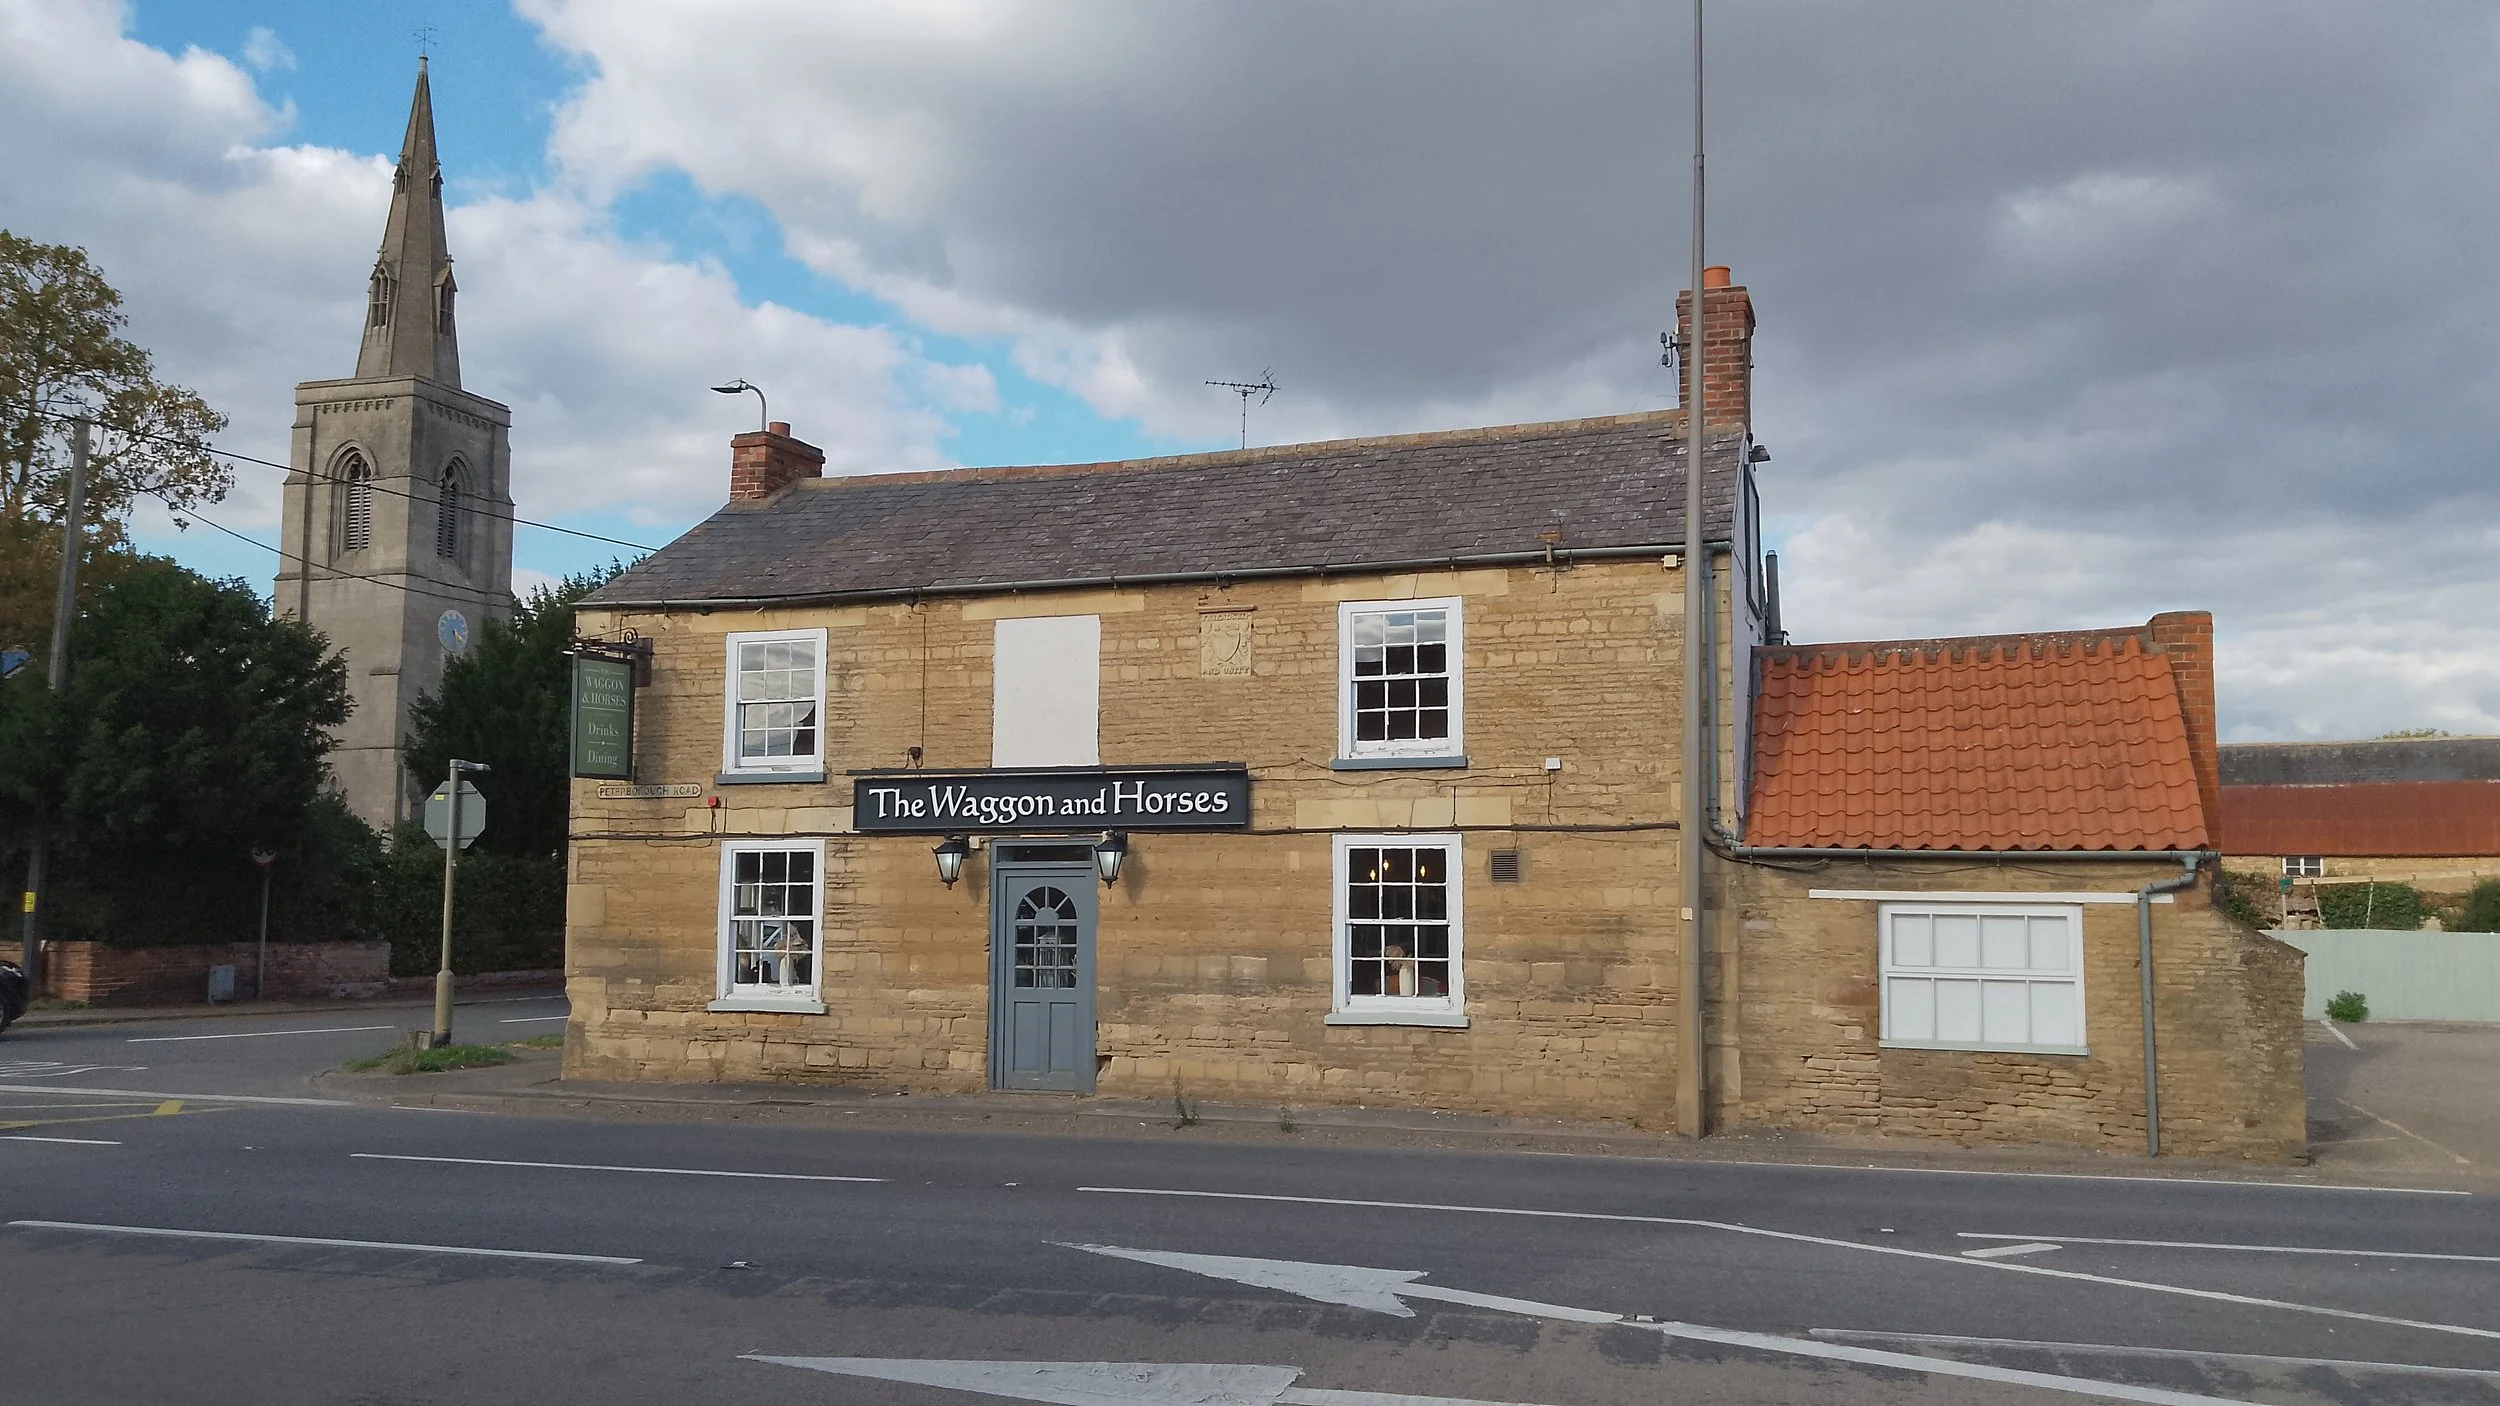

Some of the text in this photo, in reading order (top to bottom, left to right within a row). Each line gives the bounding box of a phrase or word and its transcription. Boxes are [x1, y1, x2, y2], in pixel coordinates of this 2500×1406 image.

[586, 676, 624, 691] WAGGON
[582, 692, 626, 707] & HORSES
[588, 722, 619, 737] Drinks
[588, 750, 618, 766] Dining
[599, 786, 700, 797] PETERBOROUGH ROAD
[868, 780, 1229, 824] The Waggon and Horses
